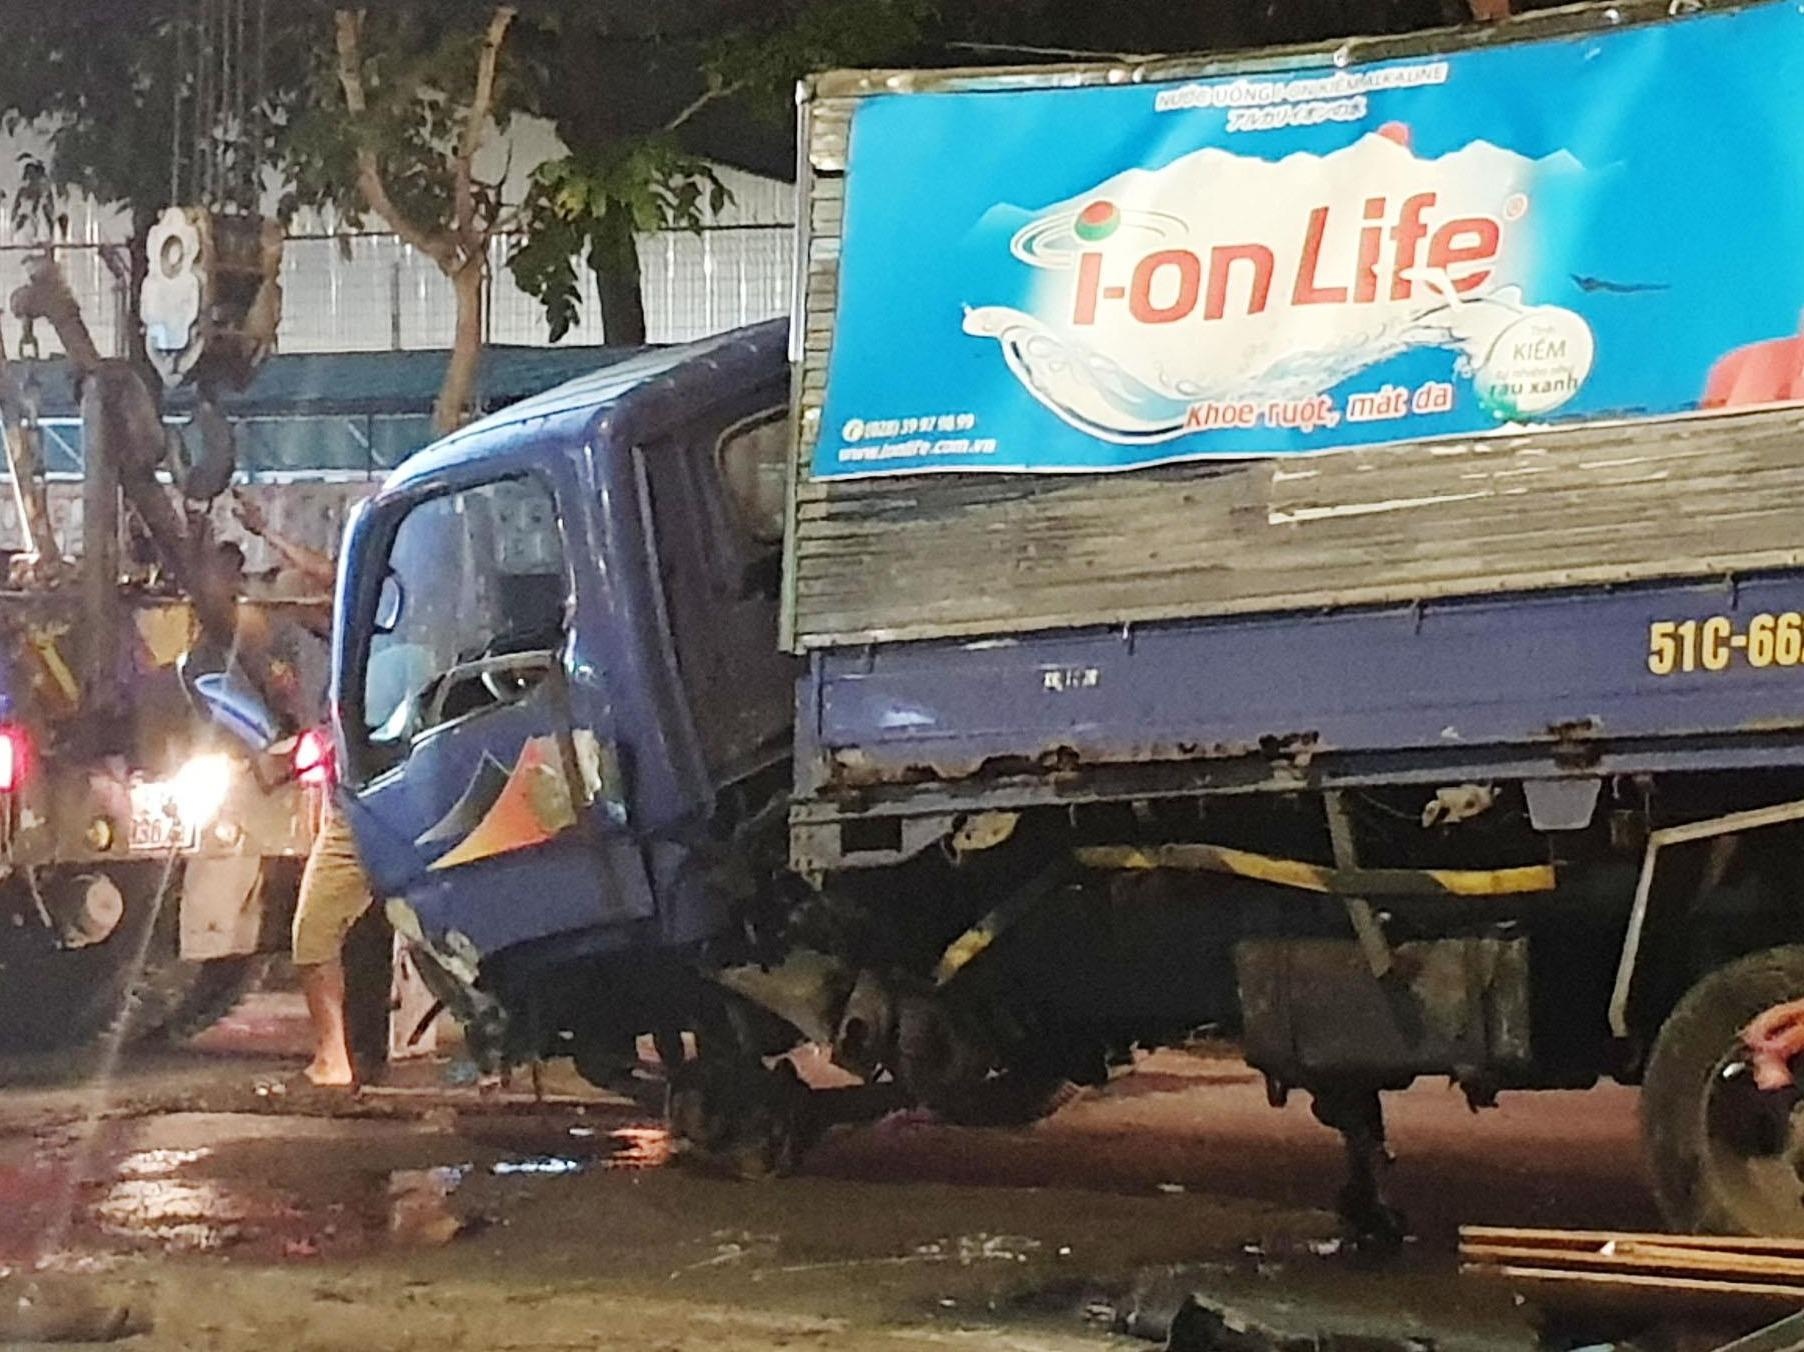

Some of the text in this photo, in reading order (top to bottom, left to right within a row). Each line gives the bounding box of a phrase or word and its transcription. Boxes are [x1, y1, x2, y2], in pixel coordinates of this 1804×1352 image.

[1291, 192, 1500, 305] Life
[1412, 382, 1452, 412] da
[1528, 372, 1578, 394] xanh
[1648, 612, 1804, 675] 51C-66
